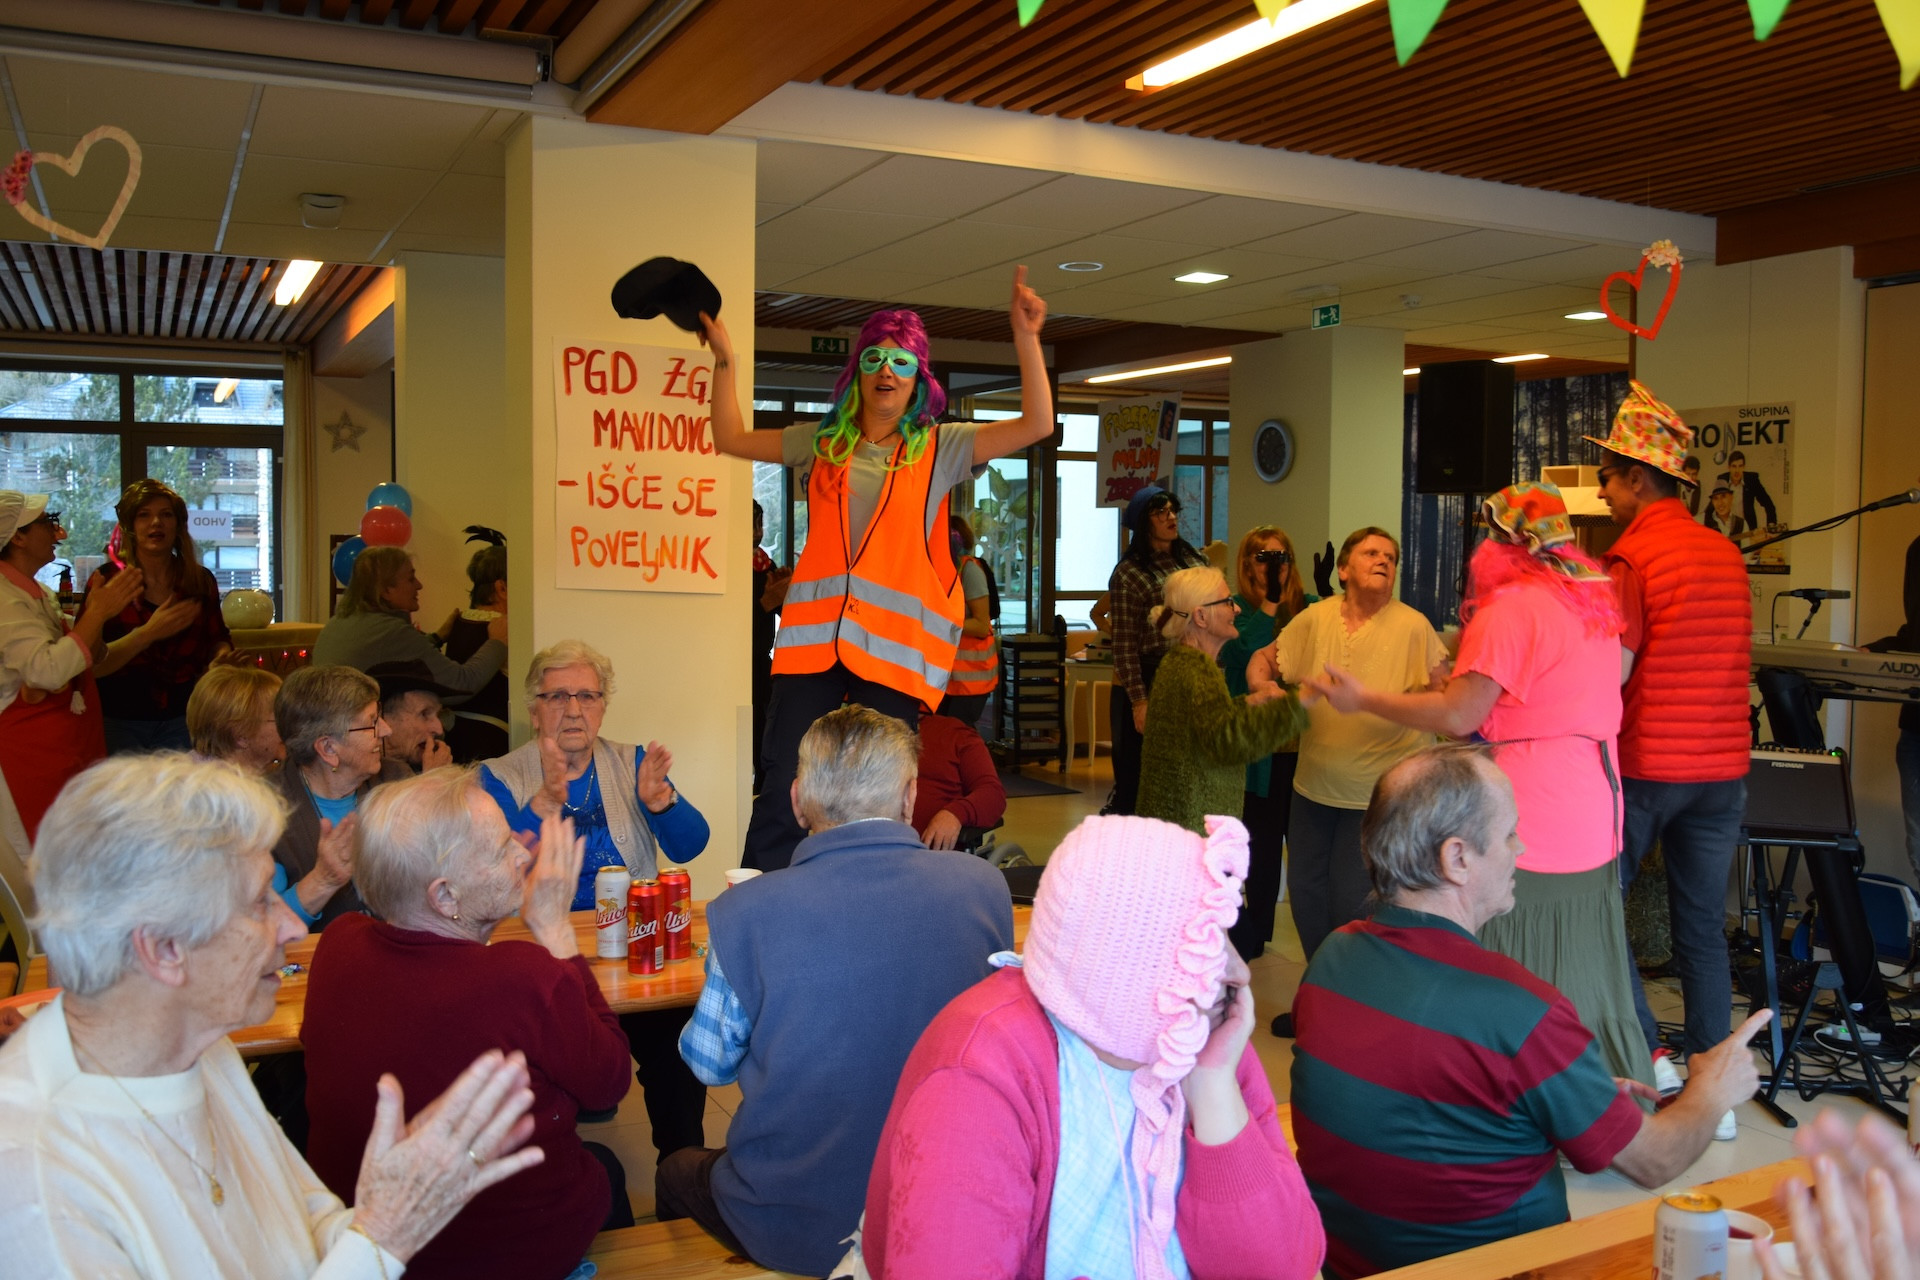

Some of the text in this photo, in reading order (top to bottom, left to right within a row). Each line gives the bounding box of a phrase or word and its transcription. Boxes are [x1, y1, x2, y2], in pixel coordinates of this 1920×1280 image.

[562, 346, 638, 396] PGD
[593, 408, 721, 456] MAVIDOVC
[1738, 405, 1790, 418] SKUPINA
[587, 462, 663, 510] IŠČE
[672, 477, 717, 517] SE
